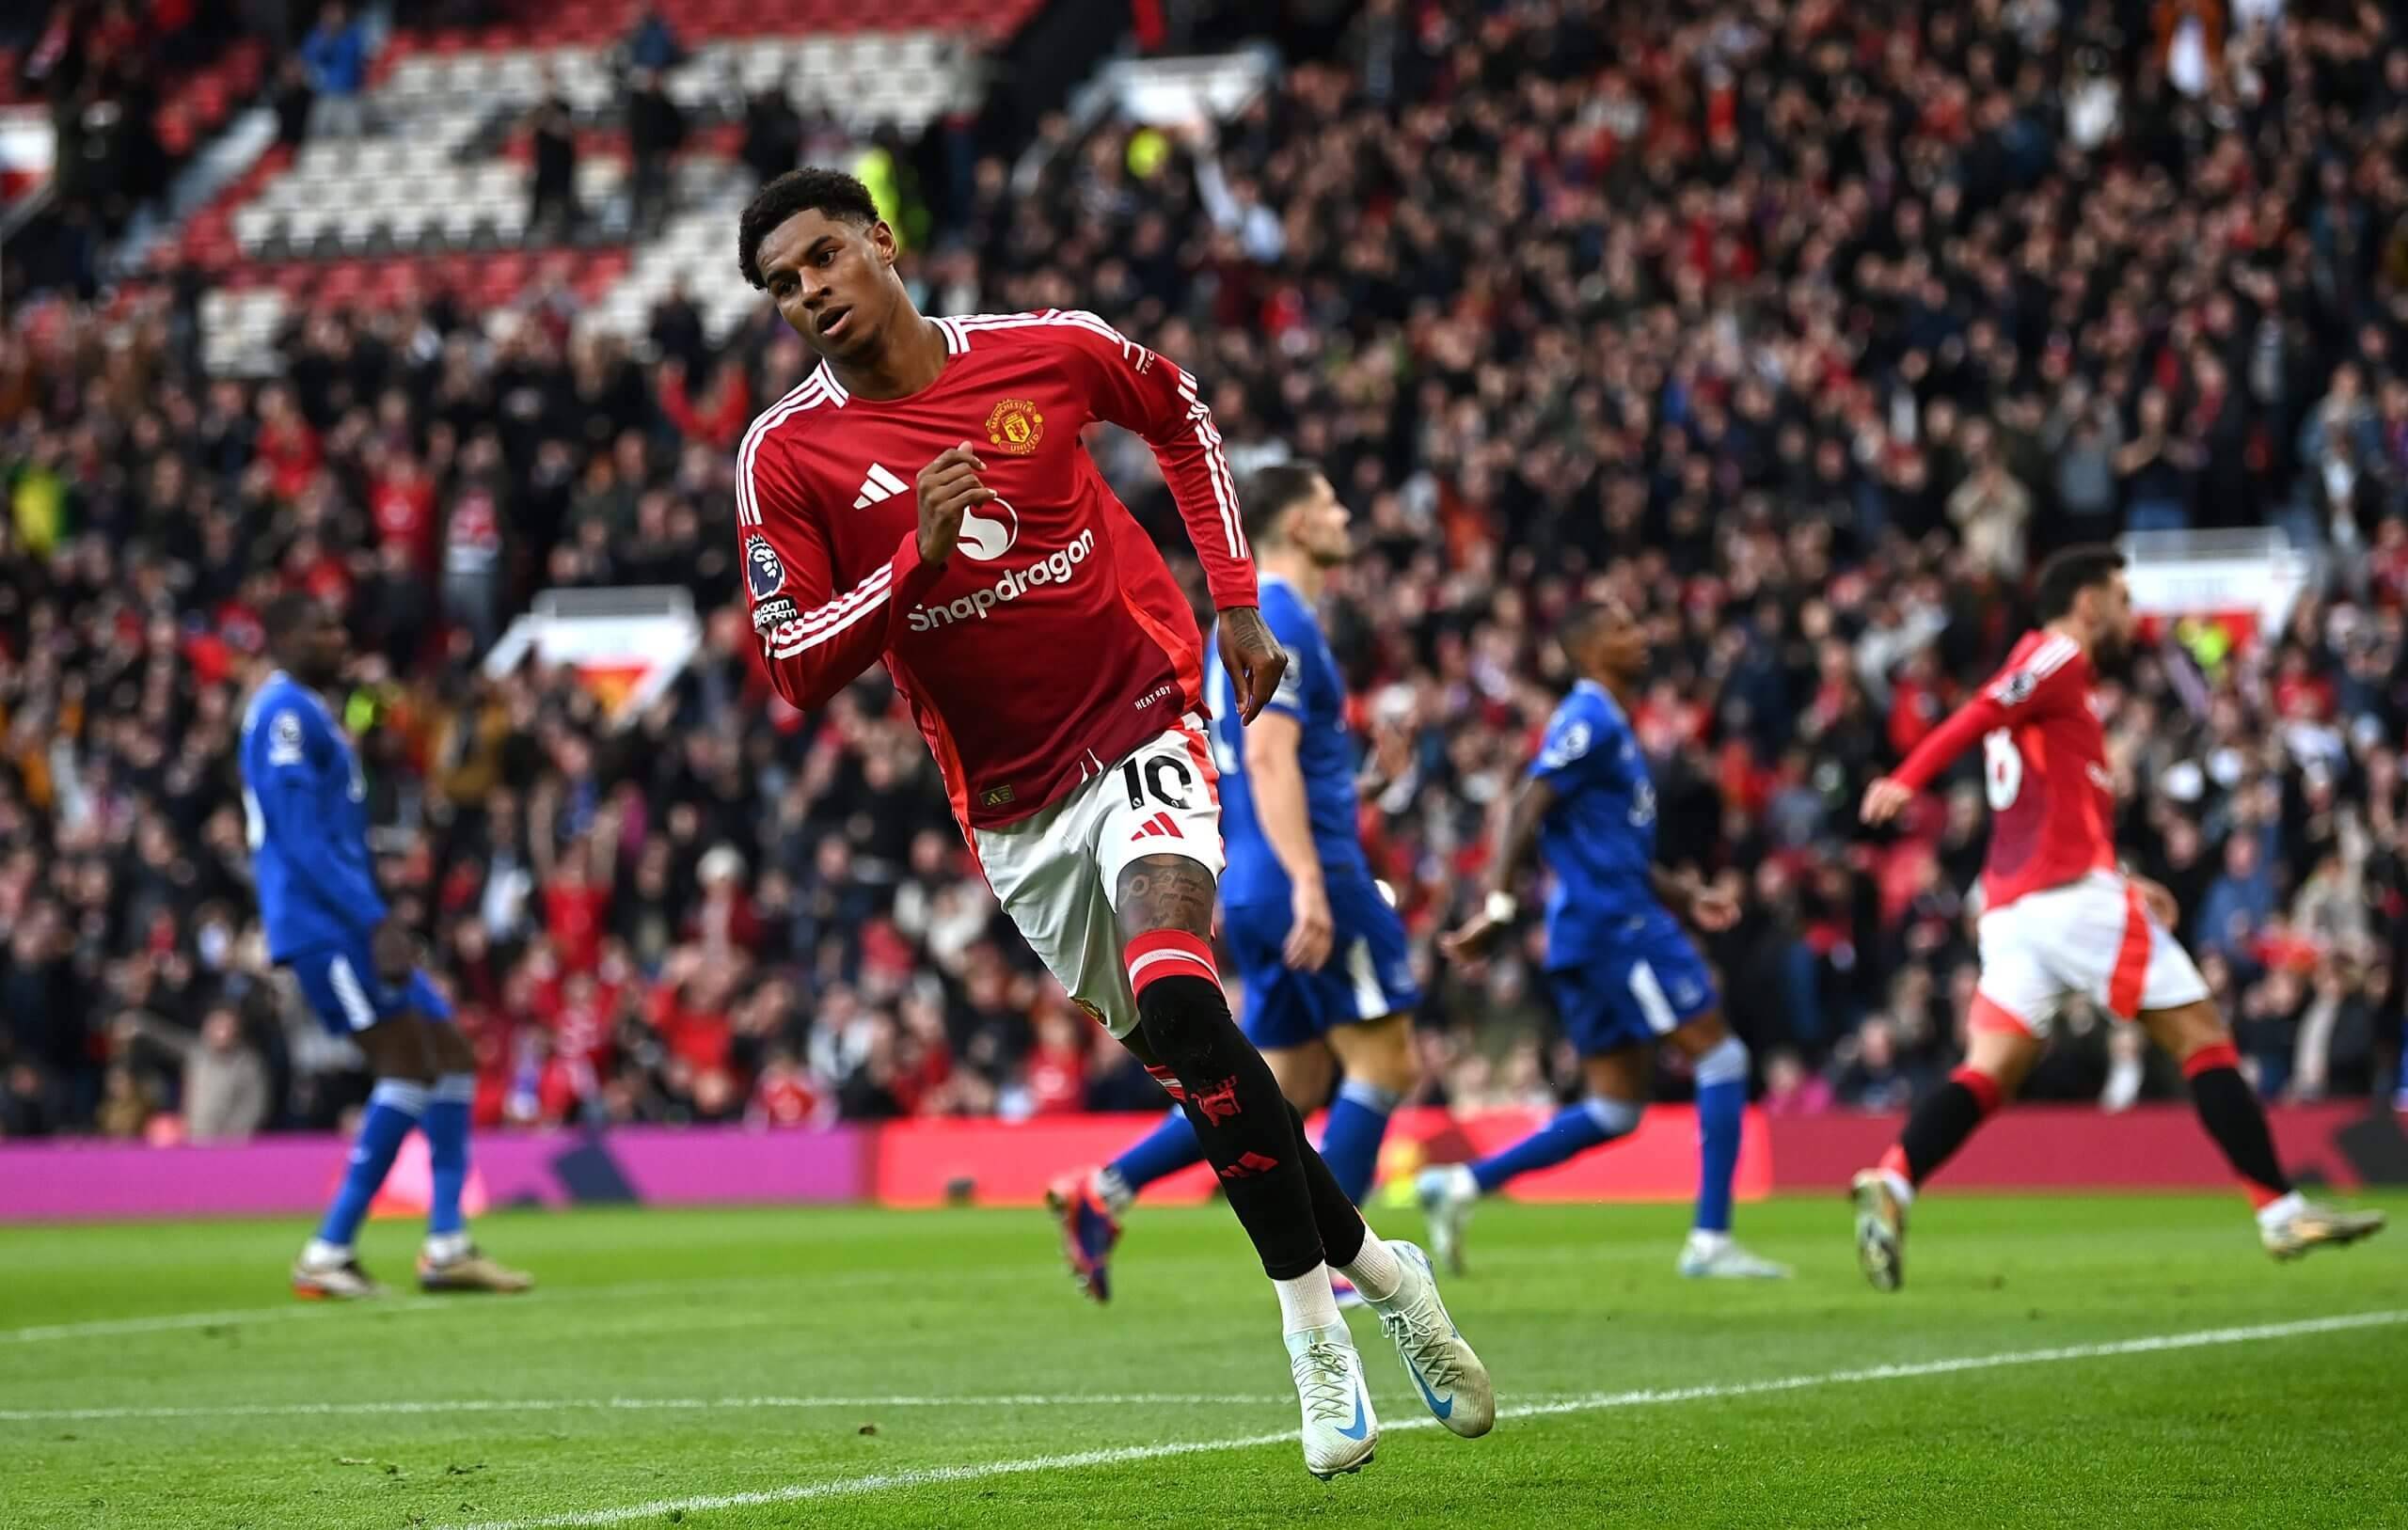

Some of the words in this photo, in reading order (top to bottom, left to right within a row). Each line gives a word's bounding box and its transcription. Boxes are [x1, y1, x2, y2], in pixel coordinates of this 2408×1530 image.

[990, 402, 1033, 430] MANCHESTER
[1010, 434, 1039, 452] UNITED
[908, 528, 1094, 632] Snapdragon
[1117, 755, 1192, 811] 10
